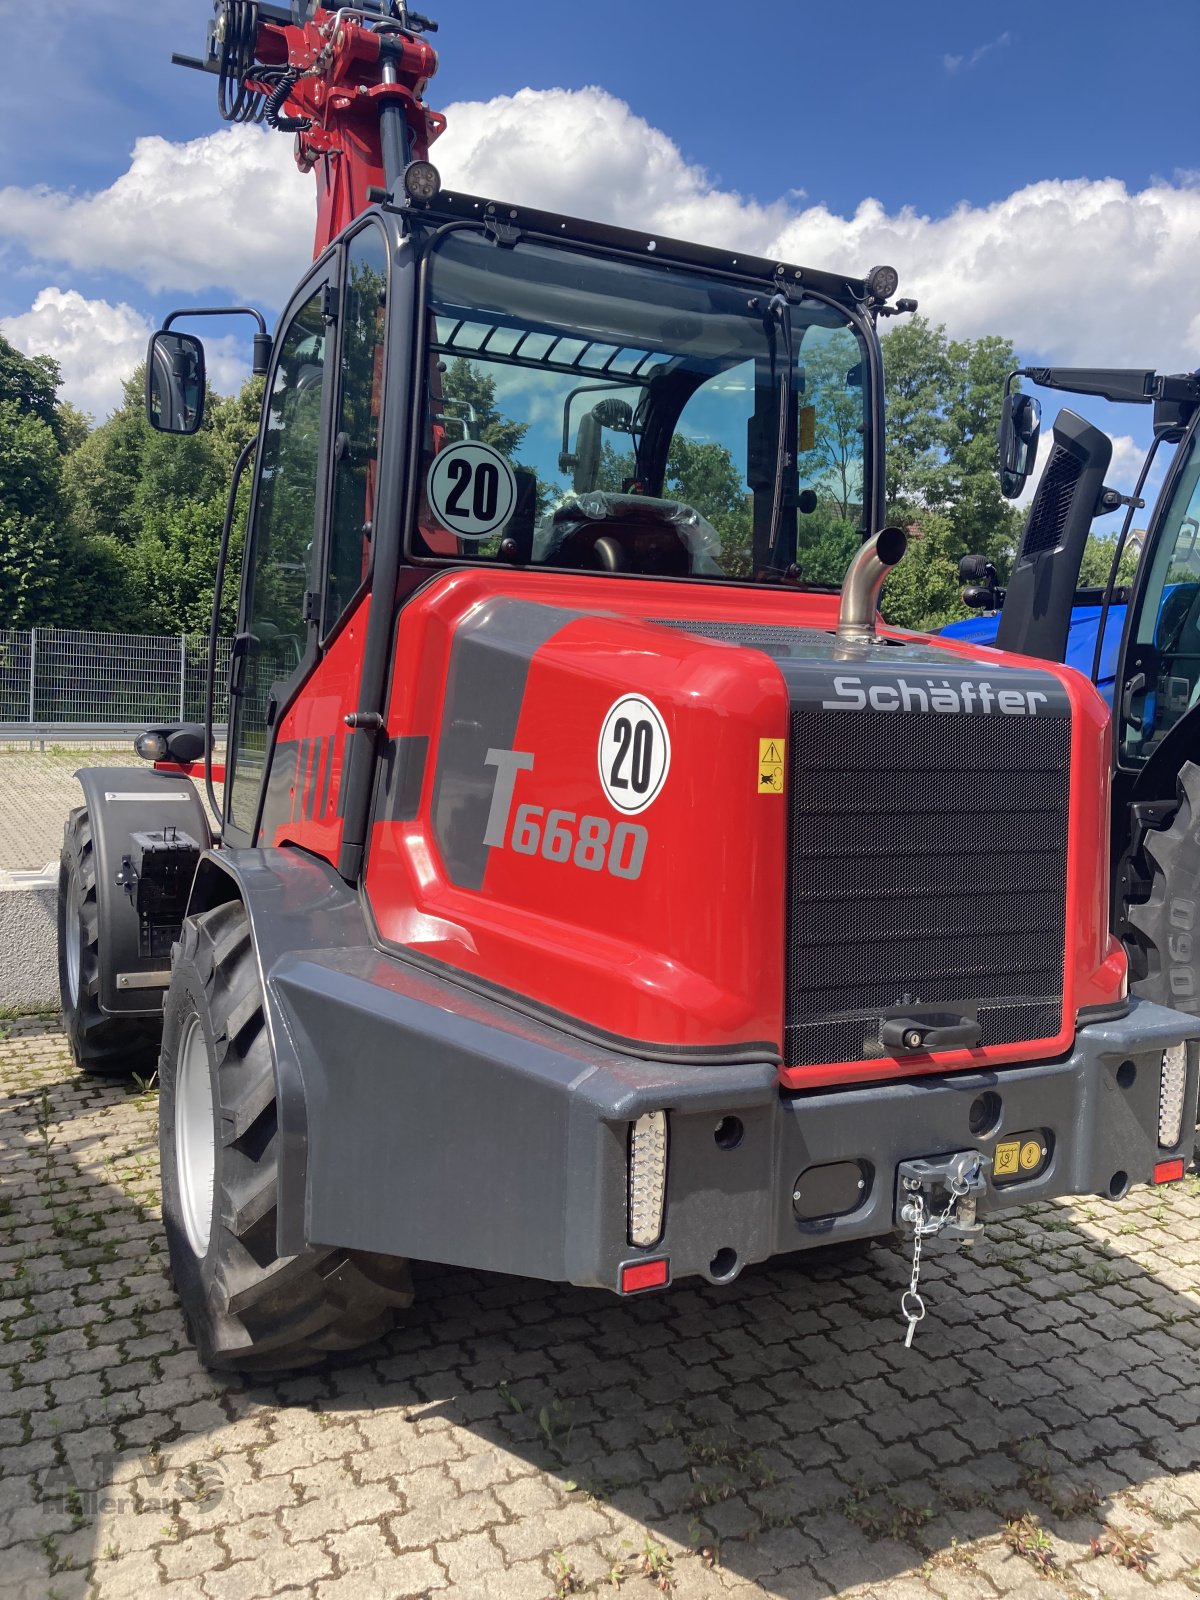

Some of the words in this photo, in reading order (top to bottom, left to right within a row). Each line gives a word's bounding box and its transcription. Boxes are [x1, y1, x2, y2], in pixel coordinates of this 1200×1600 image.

[445, 458, 499, 522] 20
[822, 676, 1048, 715] Schäffer
[609, 716, 654, 795] 20
